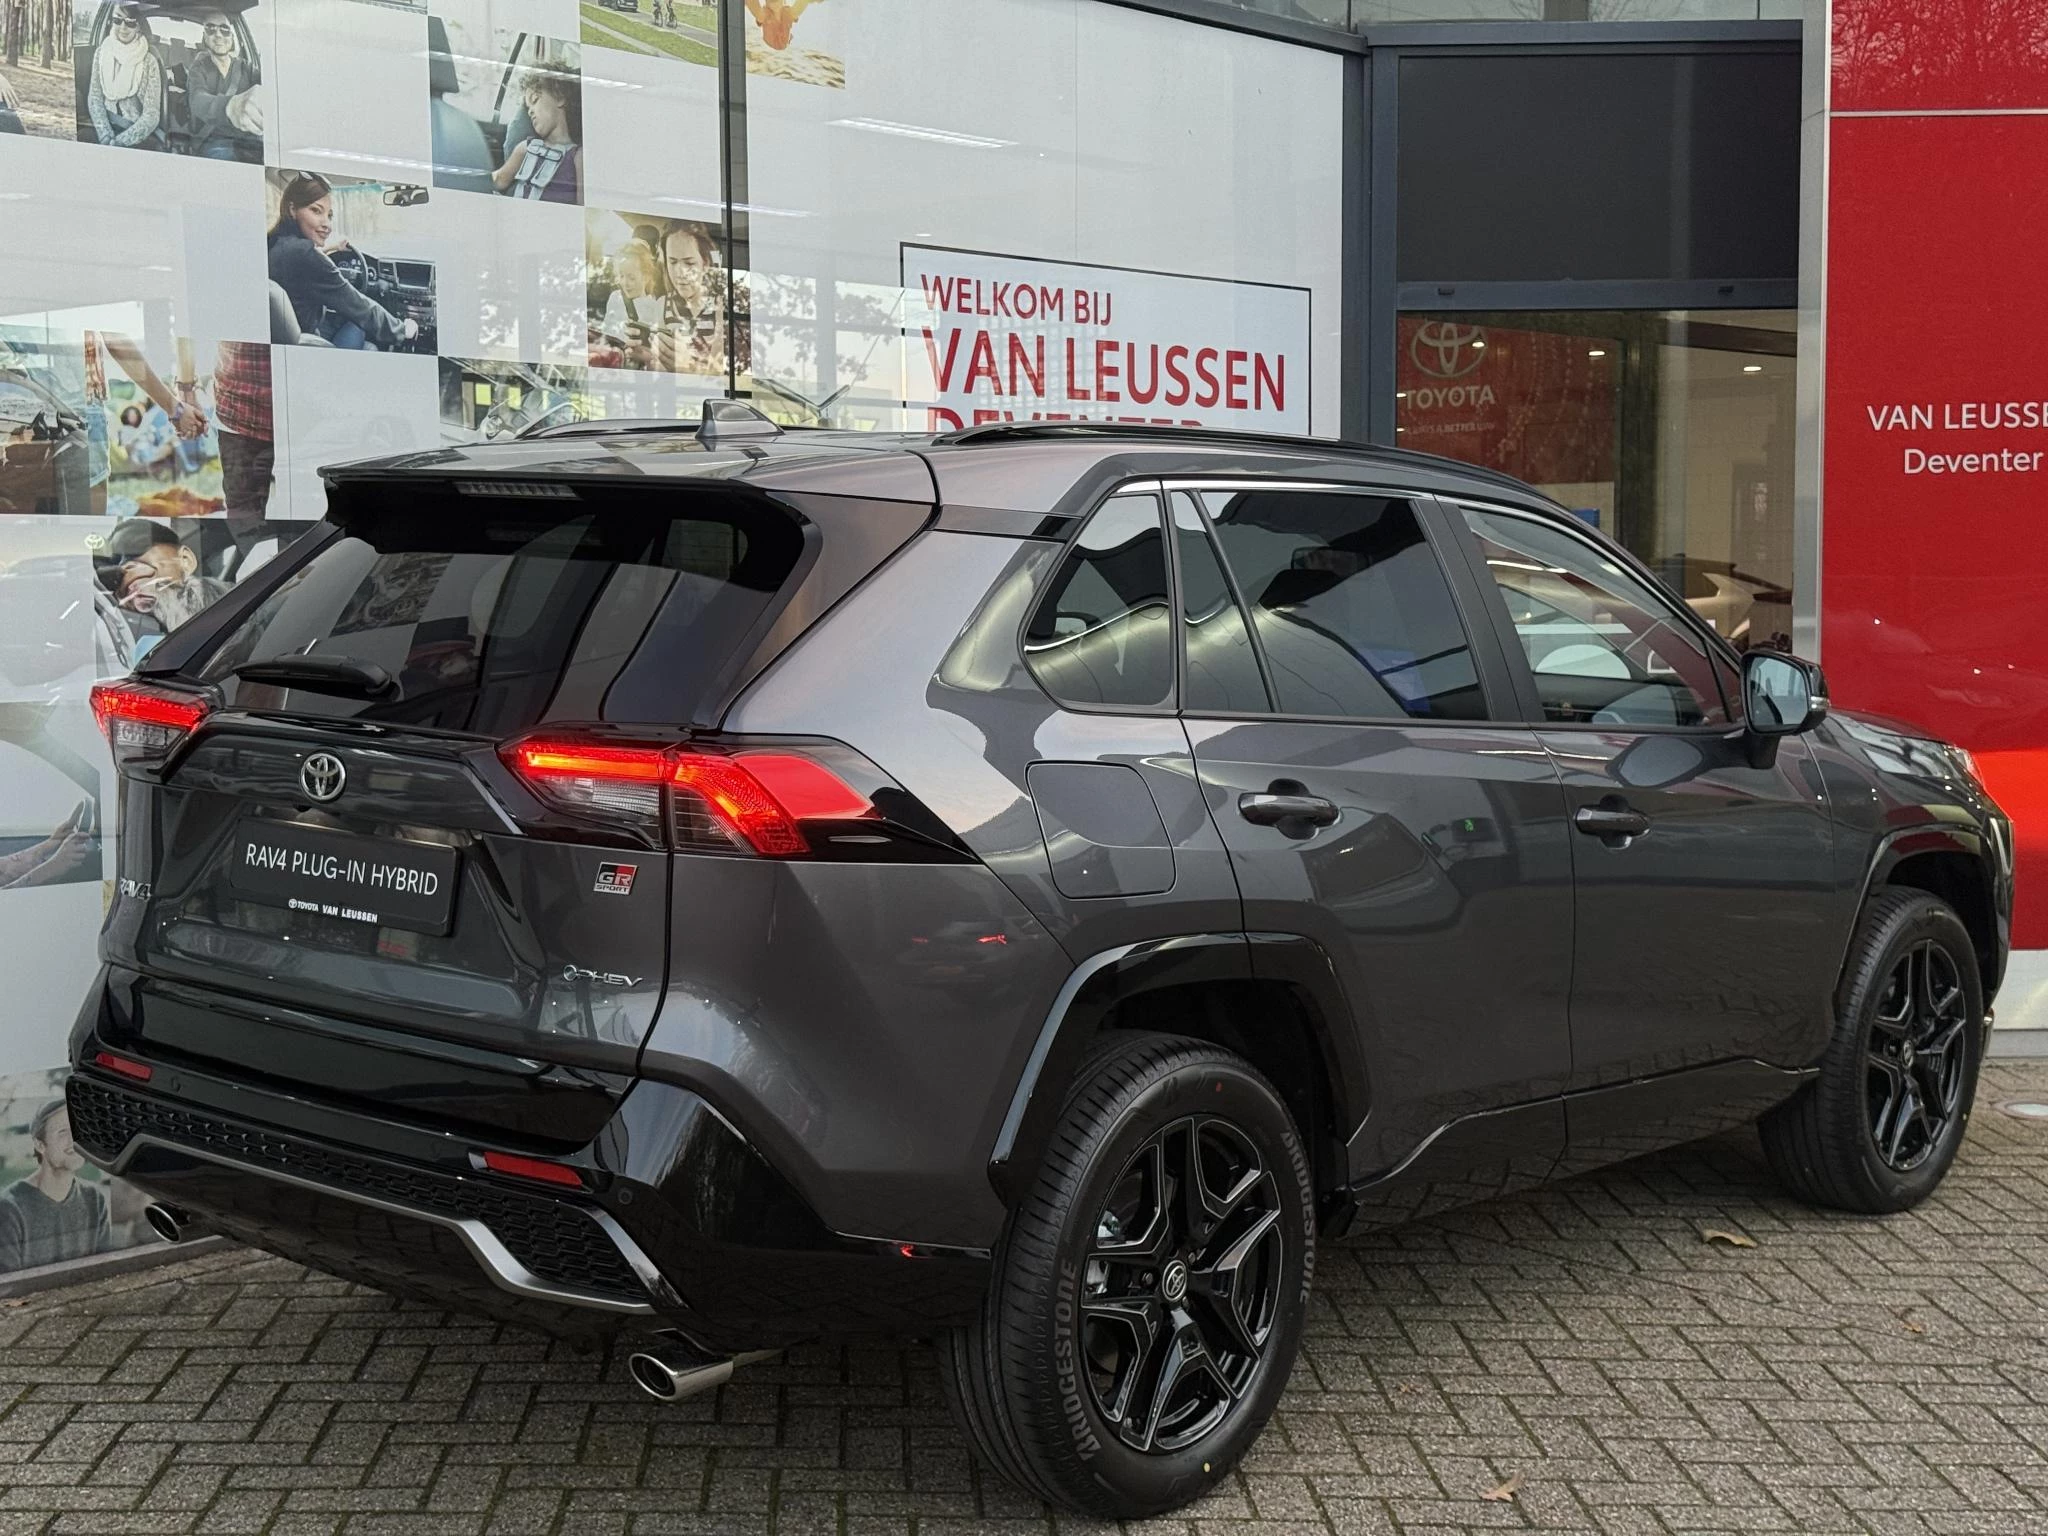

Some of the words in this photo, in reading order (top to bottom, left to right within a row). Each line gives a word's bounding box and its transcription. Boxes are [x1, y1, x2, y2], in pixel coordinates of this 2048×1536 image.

[920, 274, 1064, 322] WELKOM
[1074, 289, 1112, 327] BIJ
[921, 326, 1045, 398] VAN
[1066, 337, 1285, 411] LEUSSEN
[1405, 384, 1496, 410] TOYOTA
[1867, 404, 1933, 431] VAN
[1904, 448, 2044, 474] Deventer
[245, 843, 287, 871] RAV4
[291, 850, 366, 885] PLUG-IN
[370, 863, 438, 896] HYBRID
[598, 871, 631, 886] GR
[595, 884, 629, 893] SPORT
[297, 901, 319, 912] TOYOTA
[322, 904, 339, 916] VAN
[341, 908, 378, 923] LEUSSEN
[1280, 1131, 1316, 1305] BRIDGESTONE
[1054, 1258, 1102, 1462] BRIDGESTONE
